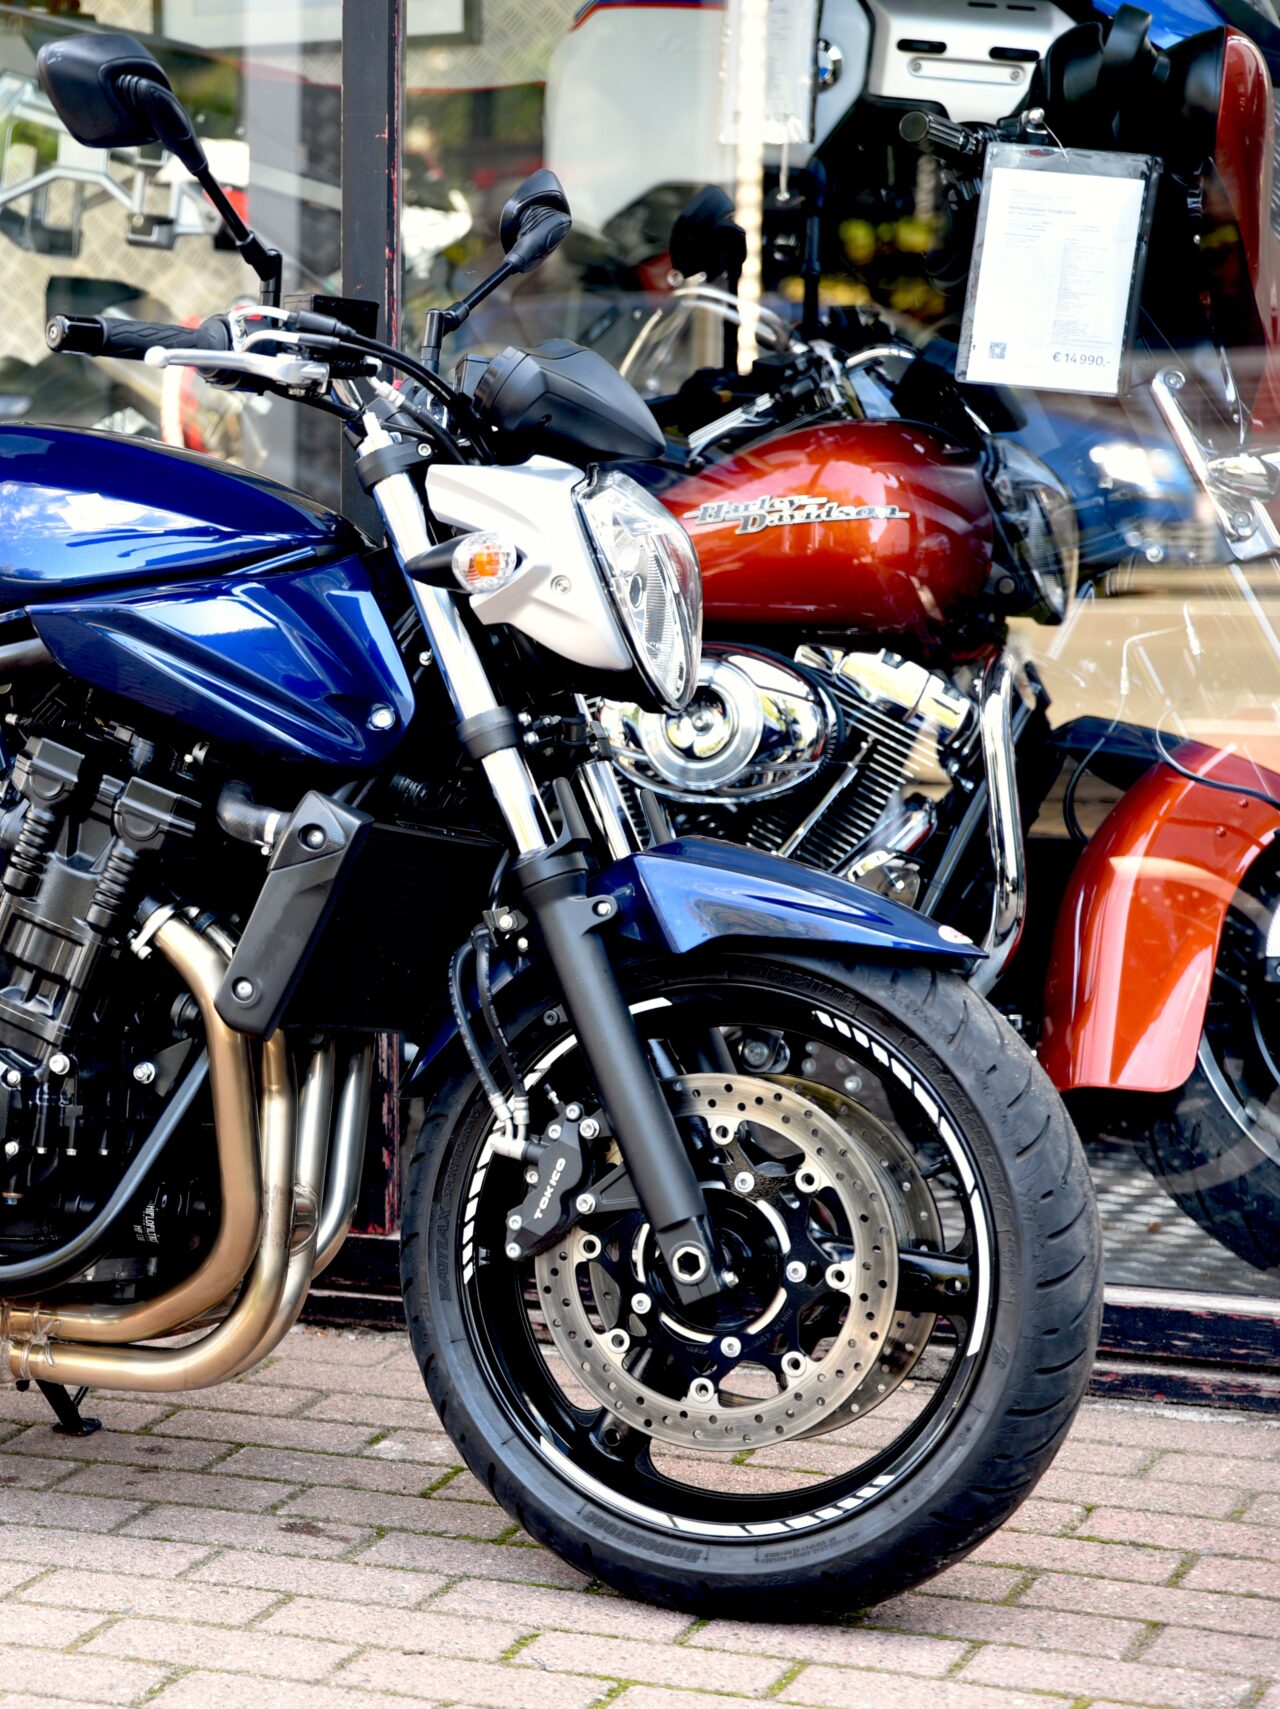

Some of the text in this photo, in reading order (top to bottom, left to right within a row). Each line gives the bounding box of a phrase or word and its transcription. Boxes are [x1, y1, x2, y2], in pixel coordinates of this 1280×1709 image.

[1052, 351, 1061, 362] €
[684, 495, 827, 526] Harley
[735, 502, 910, 534] Davidson
[533, 1157, 567, 1220] TOKICO
[579, 1510, 704, 1565] BRIDGESTONE
